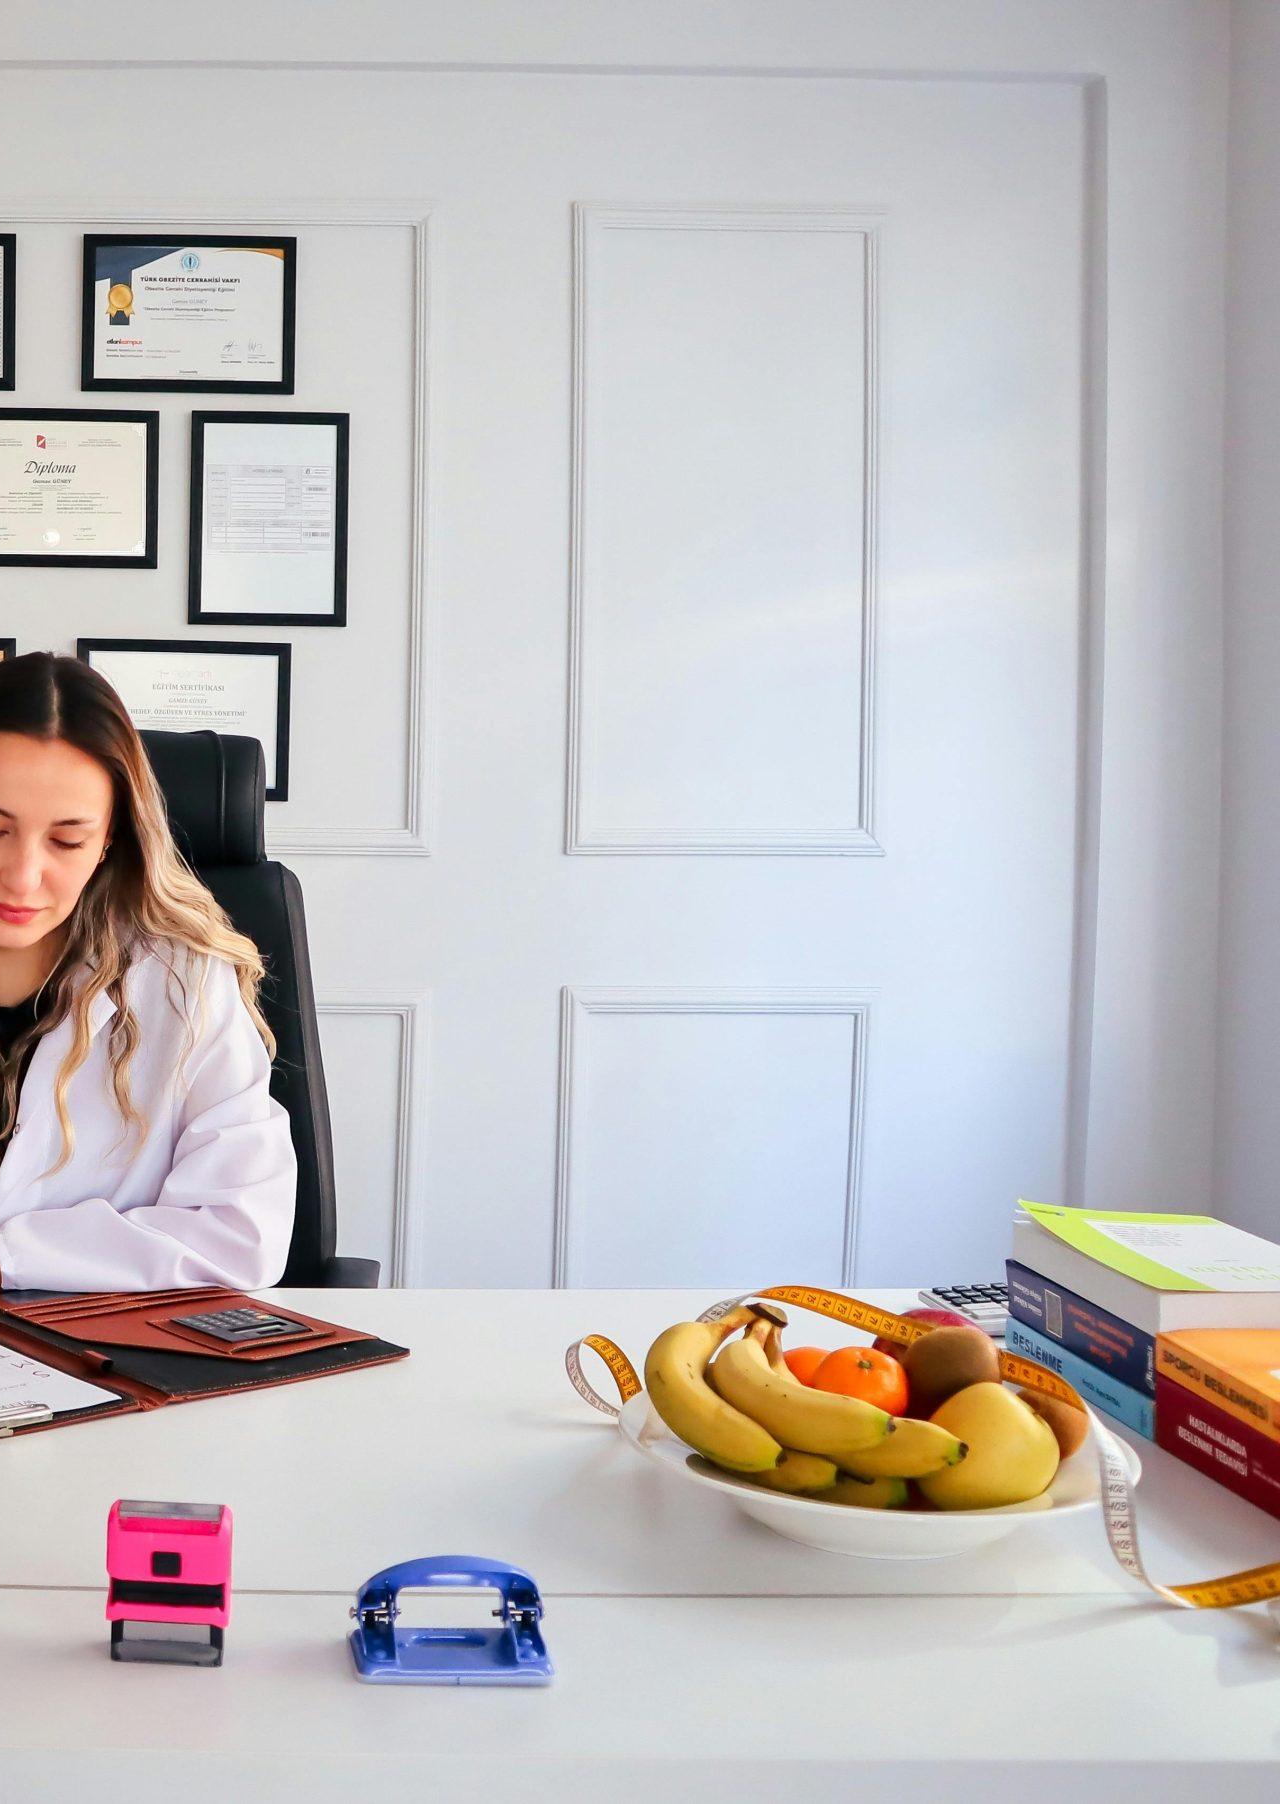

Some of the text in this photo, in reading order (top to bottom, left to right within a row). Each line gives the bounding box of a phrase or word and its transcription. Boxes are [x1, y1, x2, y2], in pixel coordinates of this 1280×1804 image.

[24, 460, 76, 476] Diploma
[807, 1294, 816, 1304] 75
[822, 1298, 831, 1309] 74
[838, 1303, 848, 1315] 73
[884, 1320, 893, 1331] 70
[1012, 1331, 1062, 1373] BESLENME
[11, 1360, 34, 1369] M
[1163, 1350, 1200, 1382] SPORCU
[1189, 1414, 1247, 1459] HASTALIKLARDA
[1178, 1425, 1247, 1477] BESLENME TEDAVİSİ
[1110, 1484, 1125, 1493] 102
[1111, 1502, 1127, 1511] 103
